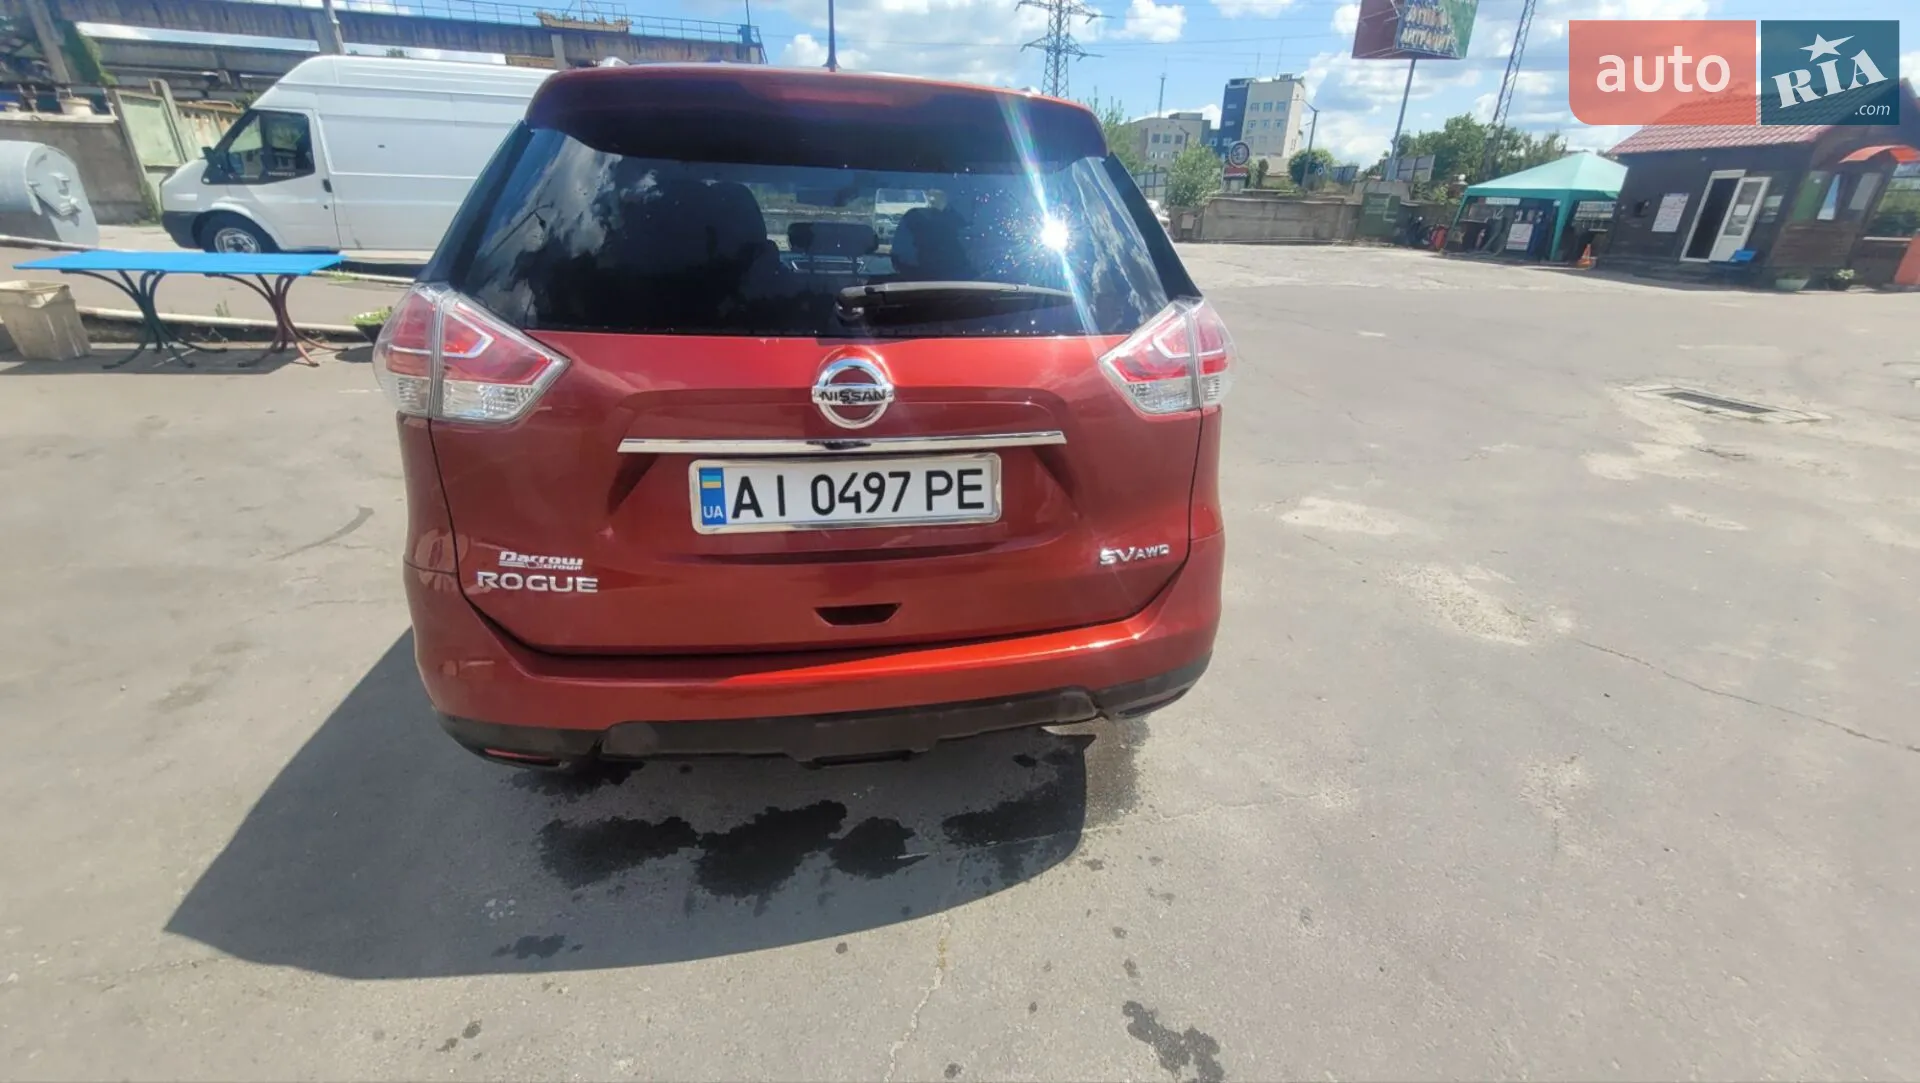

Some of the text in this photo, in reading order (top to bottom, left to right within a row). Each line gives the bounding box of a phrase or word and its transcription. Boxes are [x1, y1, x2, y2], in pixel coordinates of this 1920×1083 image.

[820, 388, 887, 402] NISSAN
[731, 468, 985, 519] AI 0497 PE
[703, 504, 724, 520] UA
[499, 551, 584, 566] Darrow
[1100, 544, 1169, 565] SV AWD
[477, 571, 598, 593] ROGUE
